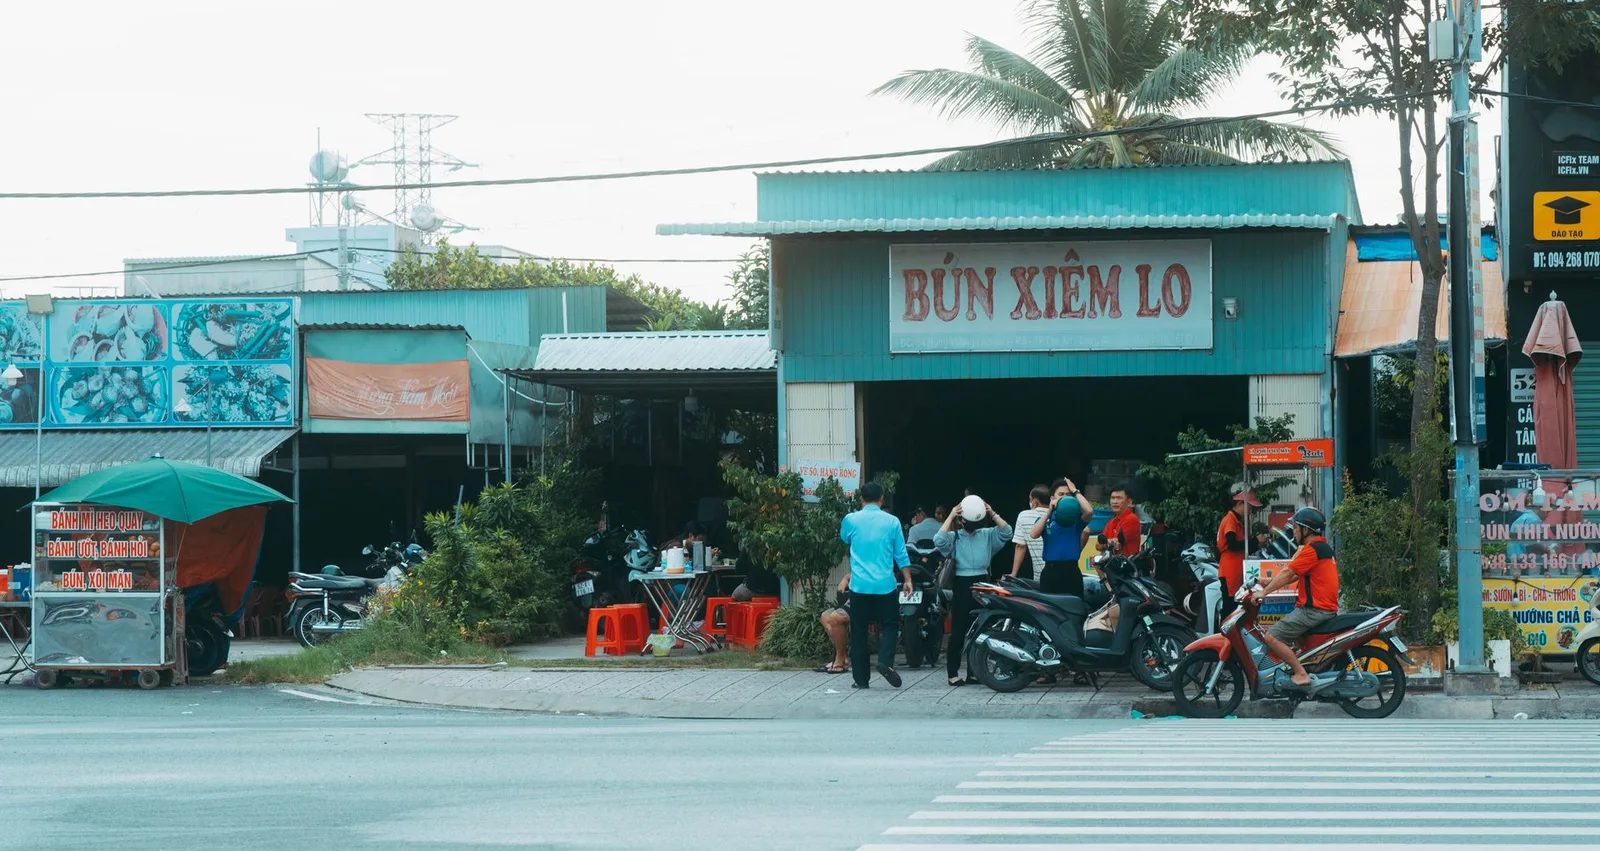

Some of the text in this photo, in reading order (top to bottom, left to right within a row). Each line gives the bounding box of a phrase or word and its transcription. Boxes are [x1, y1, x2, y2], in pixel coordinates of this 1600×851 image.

[1578, 155, 1600, 164] TEAM
[1548, 251, 1564, 268] 094
[1565, 251, 1582, 268] 268
[1583, 251, 1600, 268] 070
[902, 248, 1192, 322] BÚN XIÊM LO
[1517, 404, 1535, 423] CÁ
[1480, 489, 1526, 512] ƠM
[51, 507, 143, 532] BÁNH MÌ HEO QUAY
[48, 538, 75, 557] BÁNH
[100, 538, 128, 557] BÁNH
[62, 568, 132, 592] BÚN, XÔI MẶN
[1513, 607, 1553, 624] NƯỚNG
[1557, 606, 1580, 623] CHẢ
